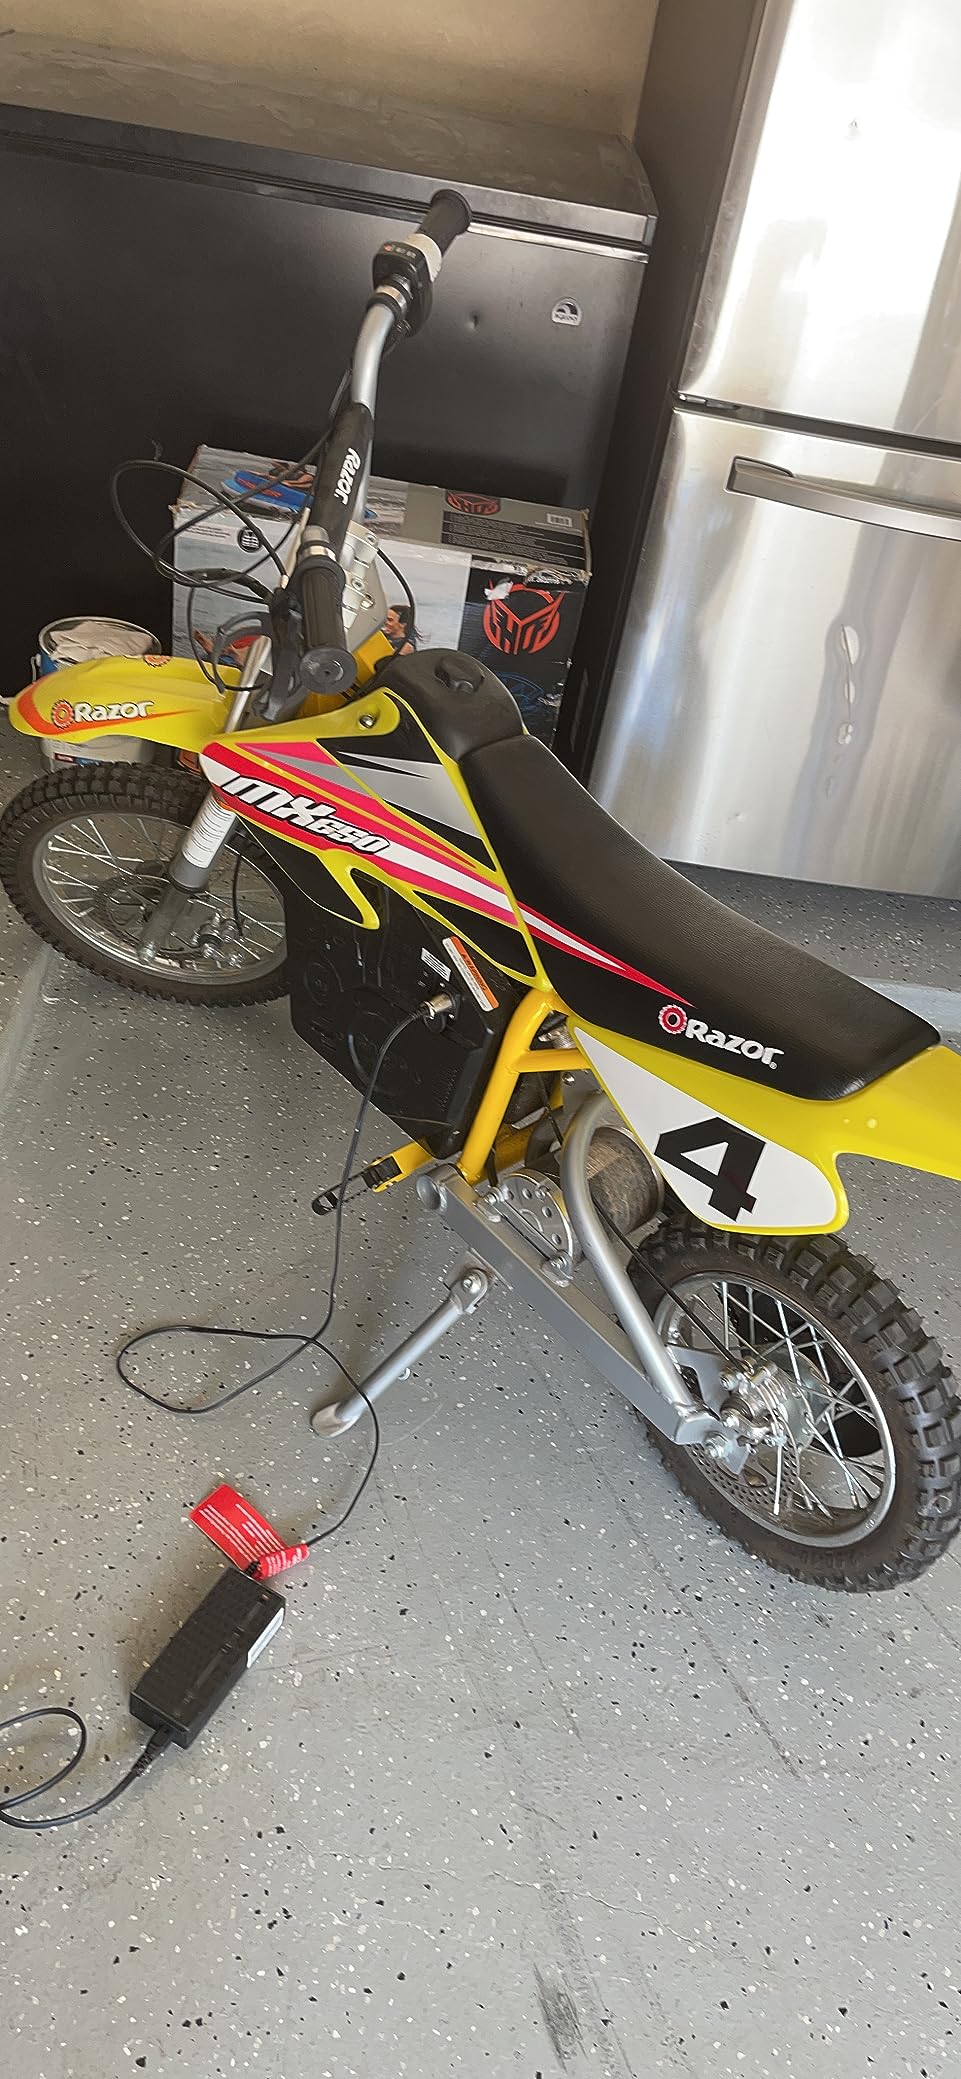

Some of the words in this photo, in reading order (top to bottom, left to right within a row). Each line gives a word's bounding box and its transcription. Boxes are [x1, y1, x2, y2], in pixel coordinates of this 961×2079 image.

[335, 447, 361, 505] Razor
[73, 701, 154, 723] Razor
[685, 1018, 785, 1065] Razor
[654, 1117, 766, 1222] 4
